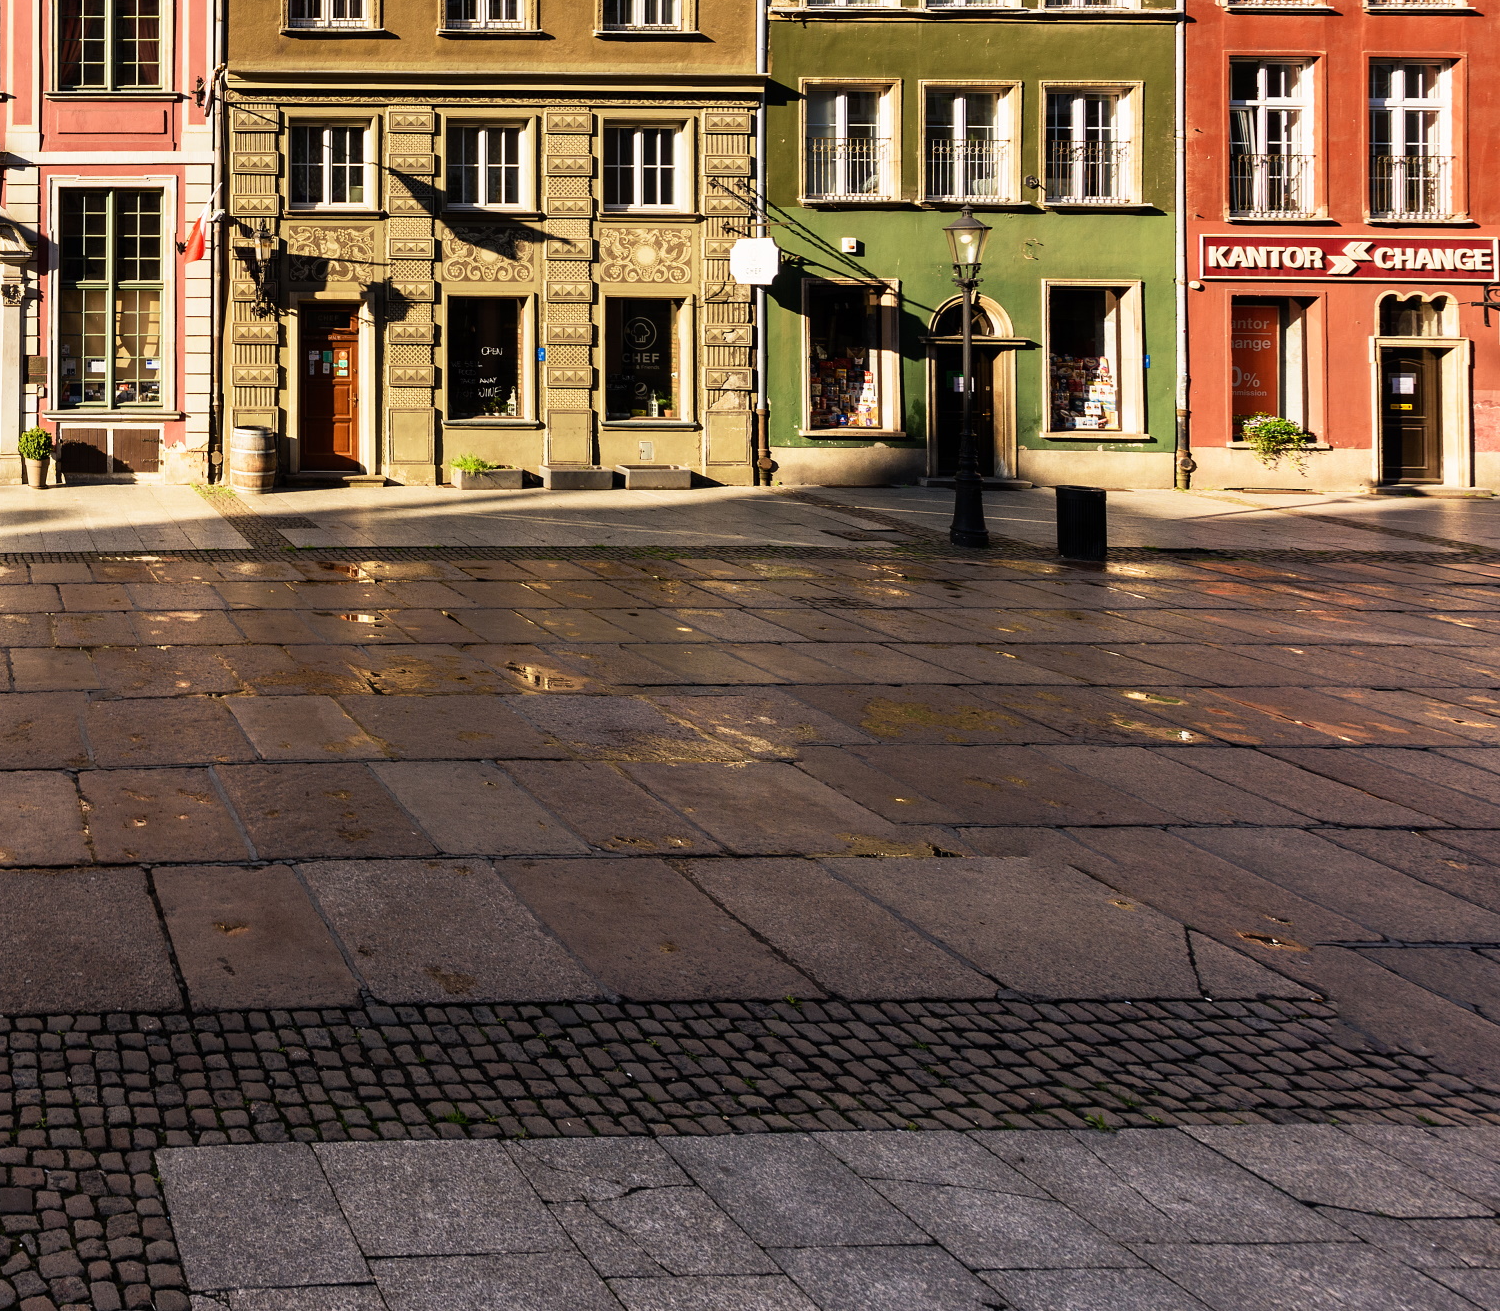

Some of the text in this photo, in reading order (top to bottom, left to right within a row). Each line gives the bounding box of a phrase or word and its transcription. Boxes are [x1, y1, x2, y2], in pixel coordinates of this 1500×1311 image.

[1208, 246, 1493, 271] KANTOR CHANGE
[1231, 317, 1270, 330] antor
[481, 346, 503, 356] OPEN
[622, 353, 660, 363] CHEF
[479, 376, 498, 384] AWAY
[478, 386, 503, 398] WINE
